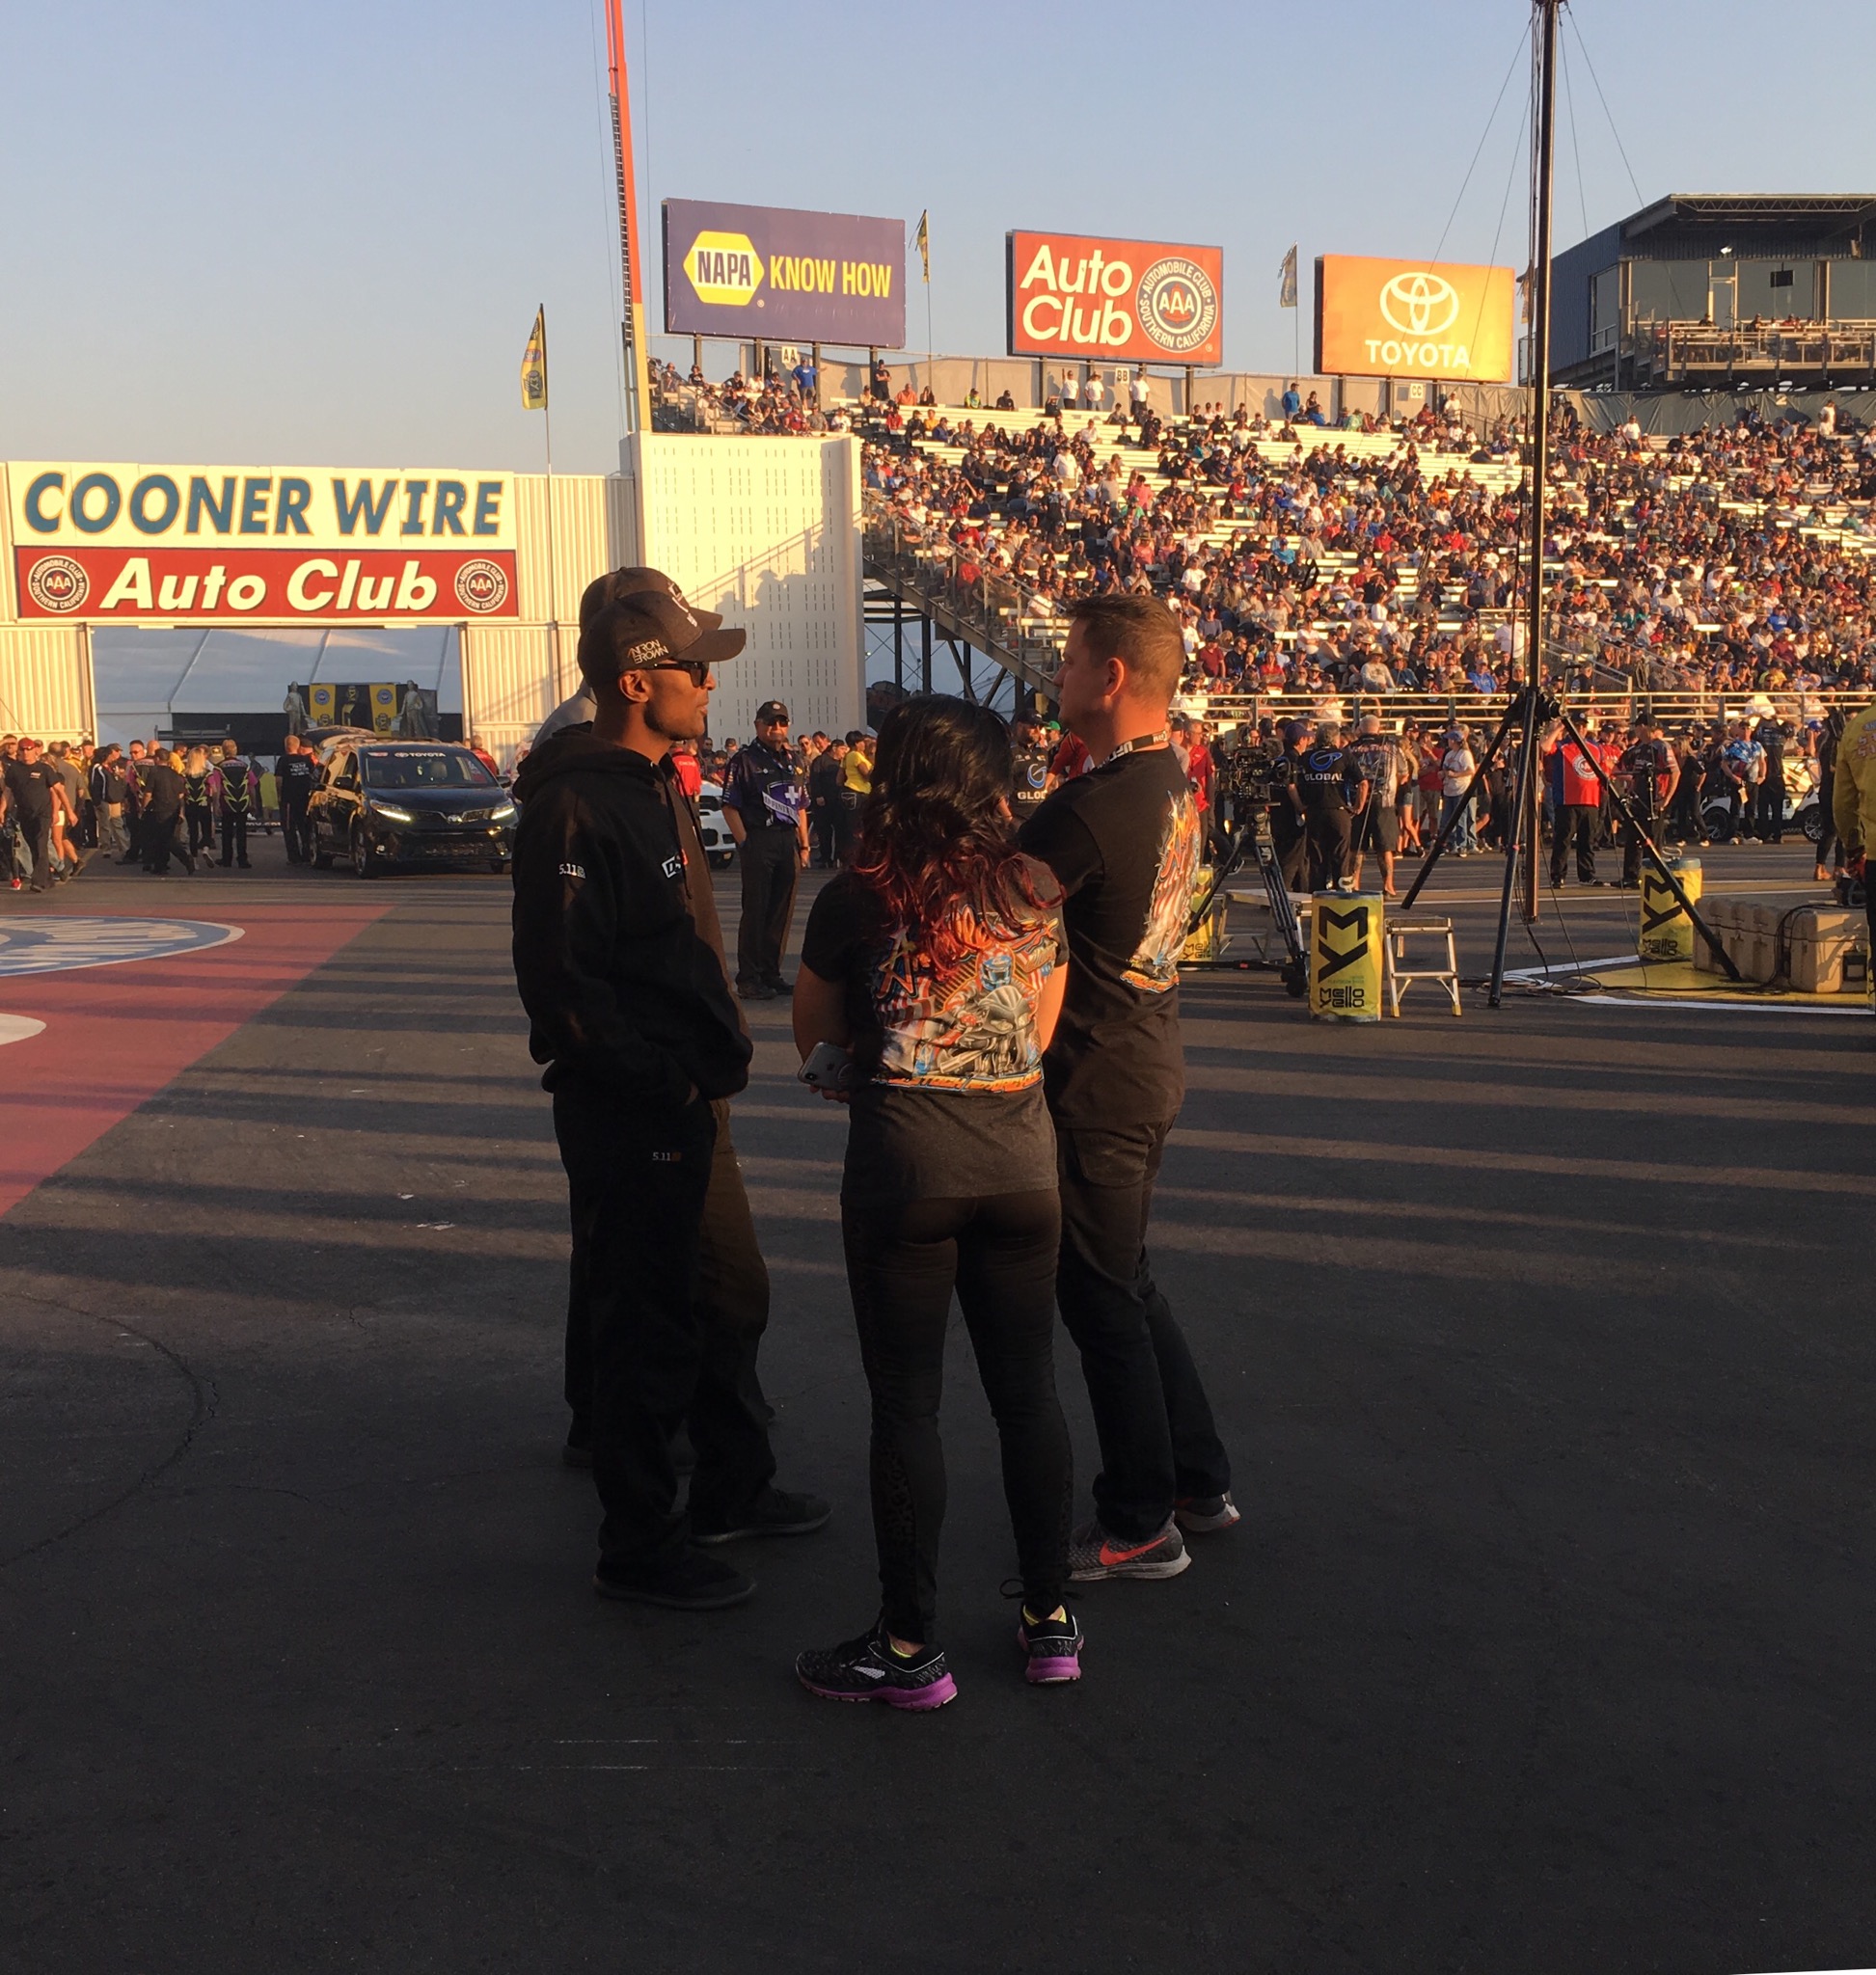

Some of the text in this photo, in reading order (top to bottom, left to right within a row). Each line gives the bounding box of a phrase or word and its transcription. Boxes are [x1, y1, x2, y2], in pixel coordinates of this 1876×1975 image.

[697, 251, 752, 287] NAPA
[770, 255, 892, 298] KNOW HOW
[1020, 244, 1132, 294] Auto
[1142, 261, 1212, 298] AUTOMOBILE CLUB
[1158, 291, 1195, 314] AAA
[1022, 295, 1132, 346] Club
[1139, 299, 1215, 348] SOUTHERN CALIFORNIA
[783, 348, 797, 363] AA
[1365, 338, 1471, 369] TOYOTA
[1411, 385, 1423, 396] CC
[23, 471, 503, 537] COONER WIRE
[46, 576, 71, 589] AAA
[68, 563, 84, 580] CLUB
[99, 557, 438, 611] Auto Club
[470, 579, 493, 591] AAA
[32, 582, 58, 609] SOUTHERN
[1304, 773, 1345, 782] GLOBAL
[1319, 986, 1365, 999] Mello
